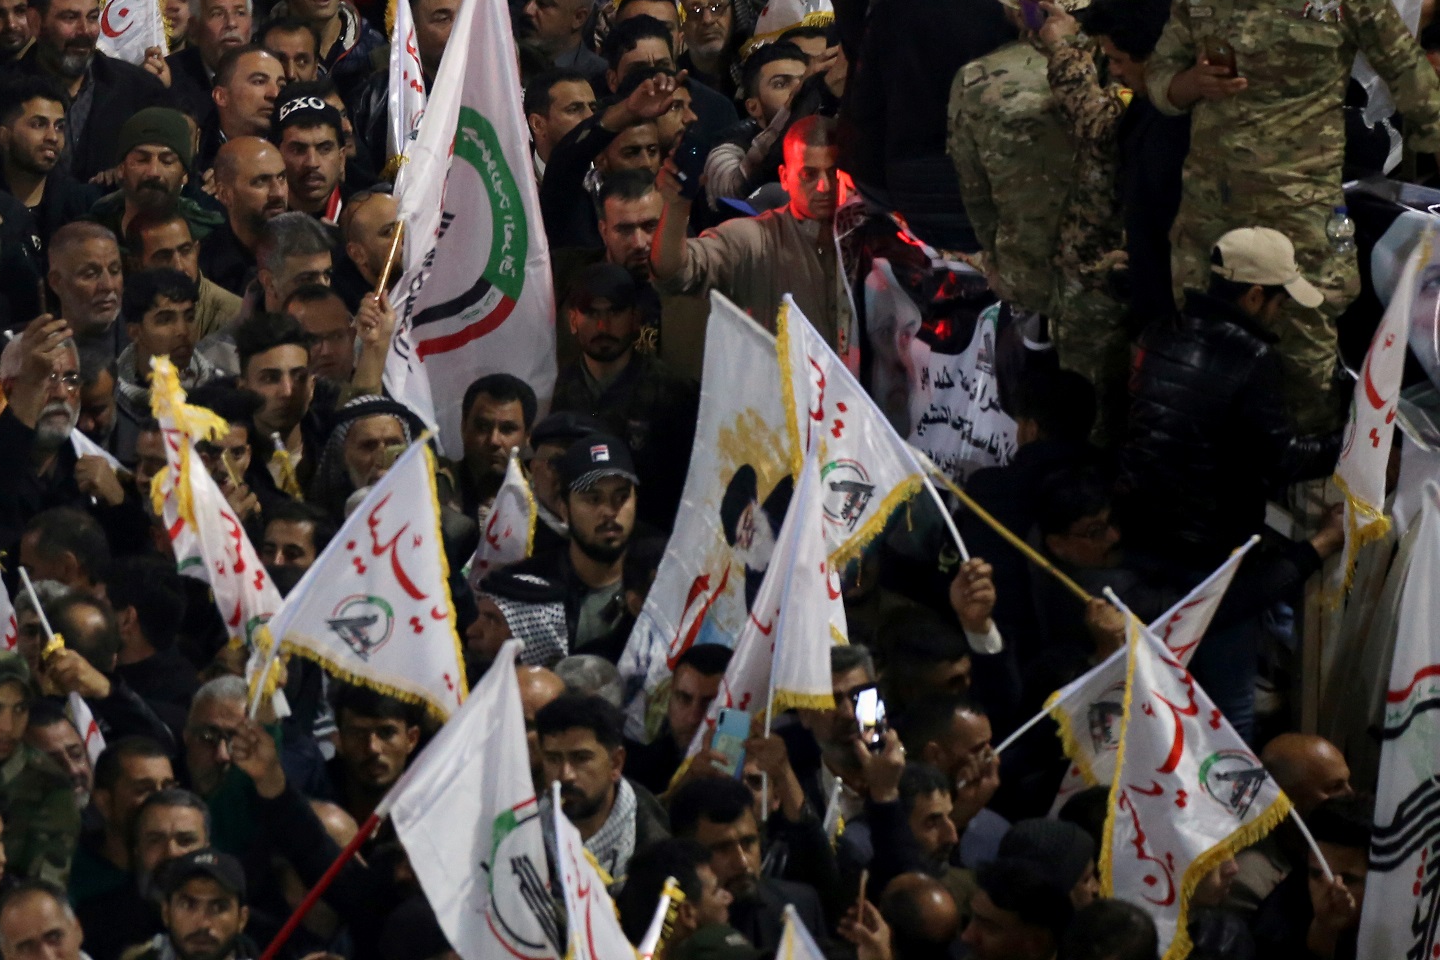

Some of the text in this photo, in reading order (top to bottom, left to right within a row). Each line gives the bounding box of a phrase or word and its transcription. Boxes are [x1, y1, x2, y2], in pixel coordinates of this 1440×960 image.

[279, 96, 325, 122] EXO
[1141, 650, 1221, 775] لبيك
[1128, 779, 1189, 809] يا
[1118, 789, 1176, 907] حسين
